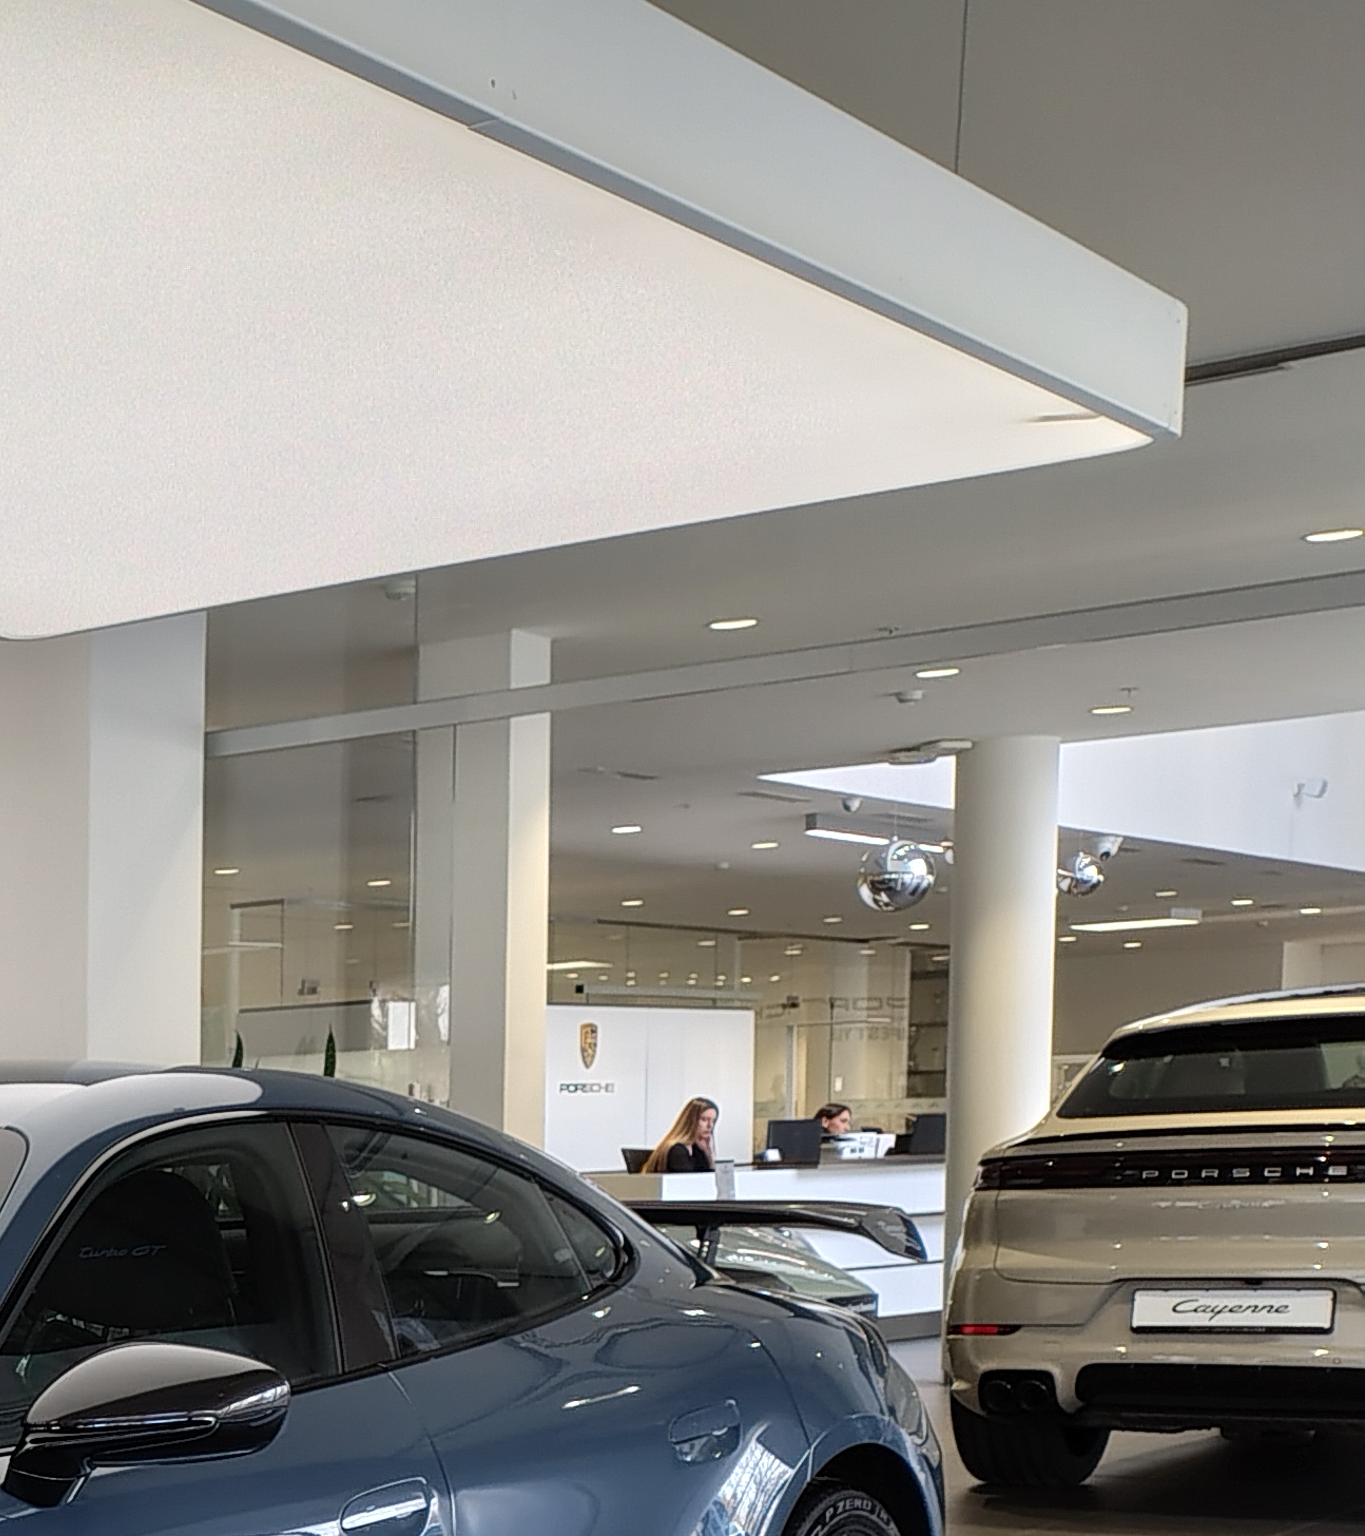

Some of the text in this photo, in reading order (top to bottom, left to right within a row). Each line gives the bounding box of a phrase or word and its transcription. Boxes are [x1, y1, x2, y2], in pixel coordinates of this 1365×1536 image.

[559, 1083, 615, 1094] PORSCHE
[1142, 1165, 1348, 1180] PORSCHE
[1171, 1299, 1290, 1322] Cayenne
